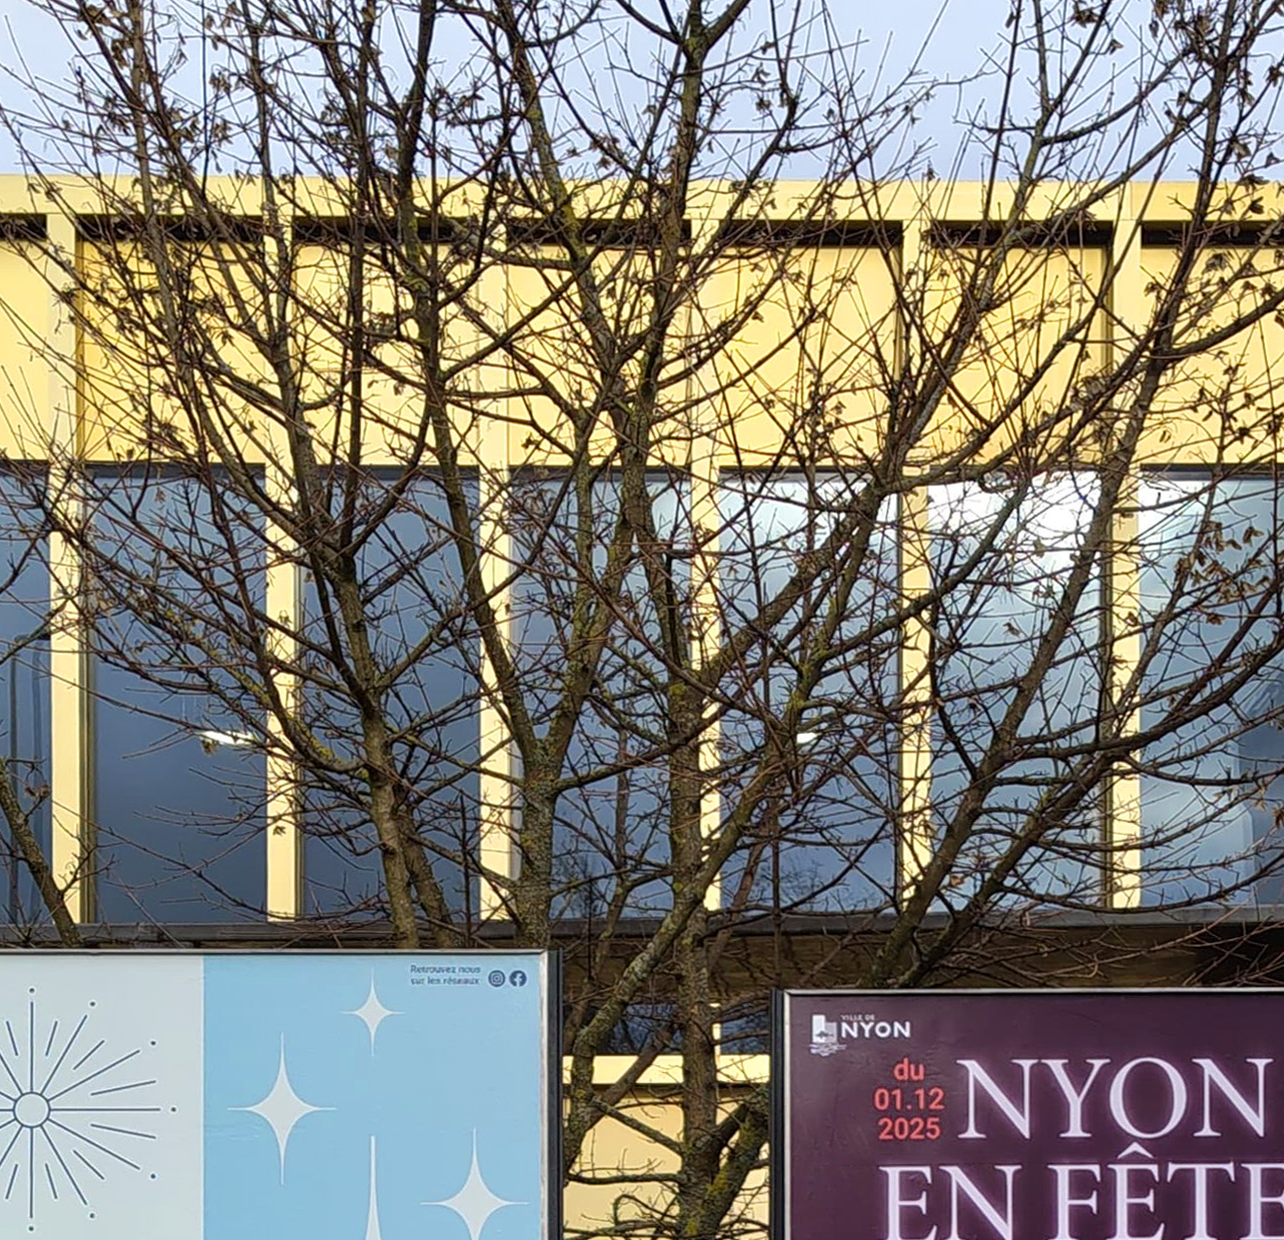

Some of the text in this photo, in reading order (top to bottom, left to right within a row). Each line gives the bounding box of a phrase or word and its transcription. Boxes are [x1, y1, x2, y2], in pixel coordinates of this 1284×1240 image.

[411, 965, 456, 973] Retrouvez
[841, 1021, 911, 1038] NYON
[894, 1058, 924, 1080] du
[875, 1088, 944, 1110] 01.12
[957, 1057, 1273, 1138] NYON
[879, 1118, 940, 1139] 2025
